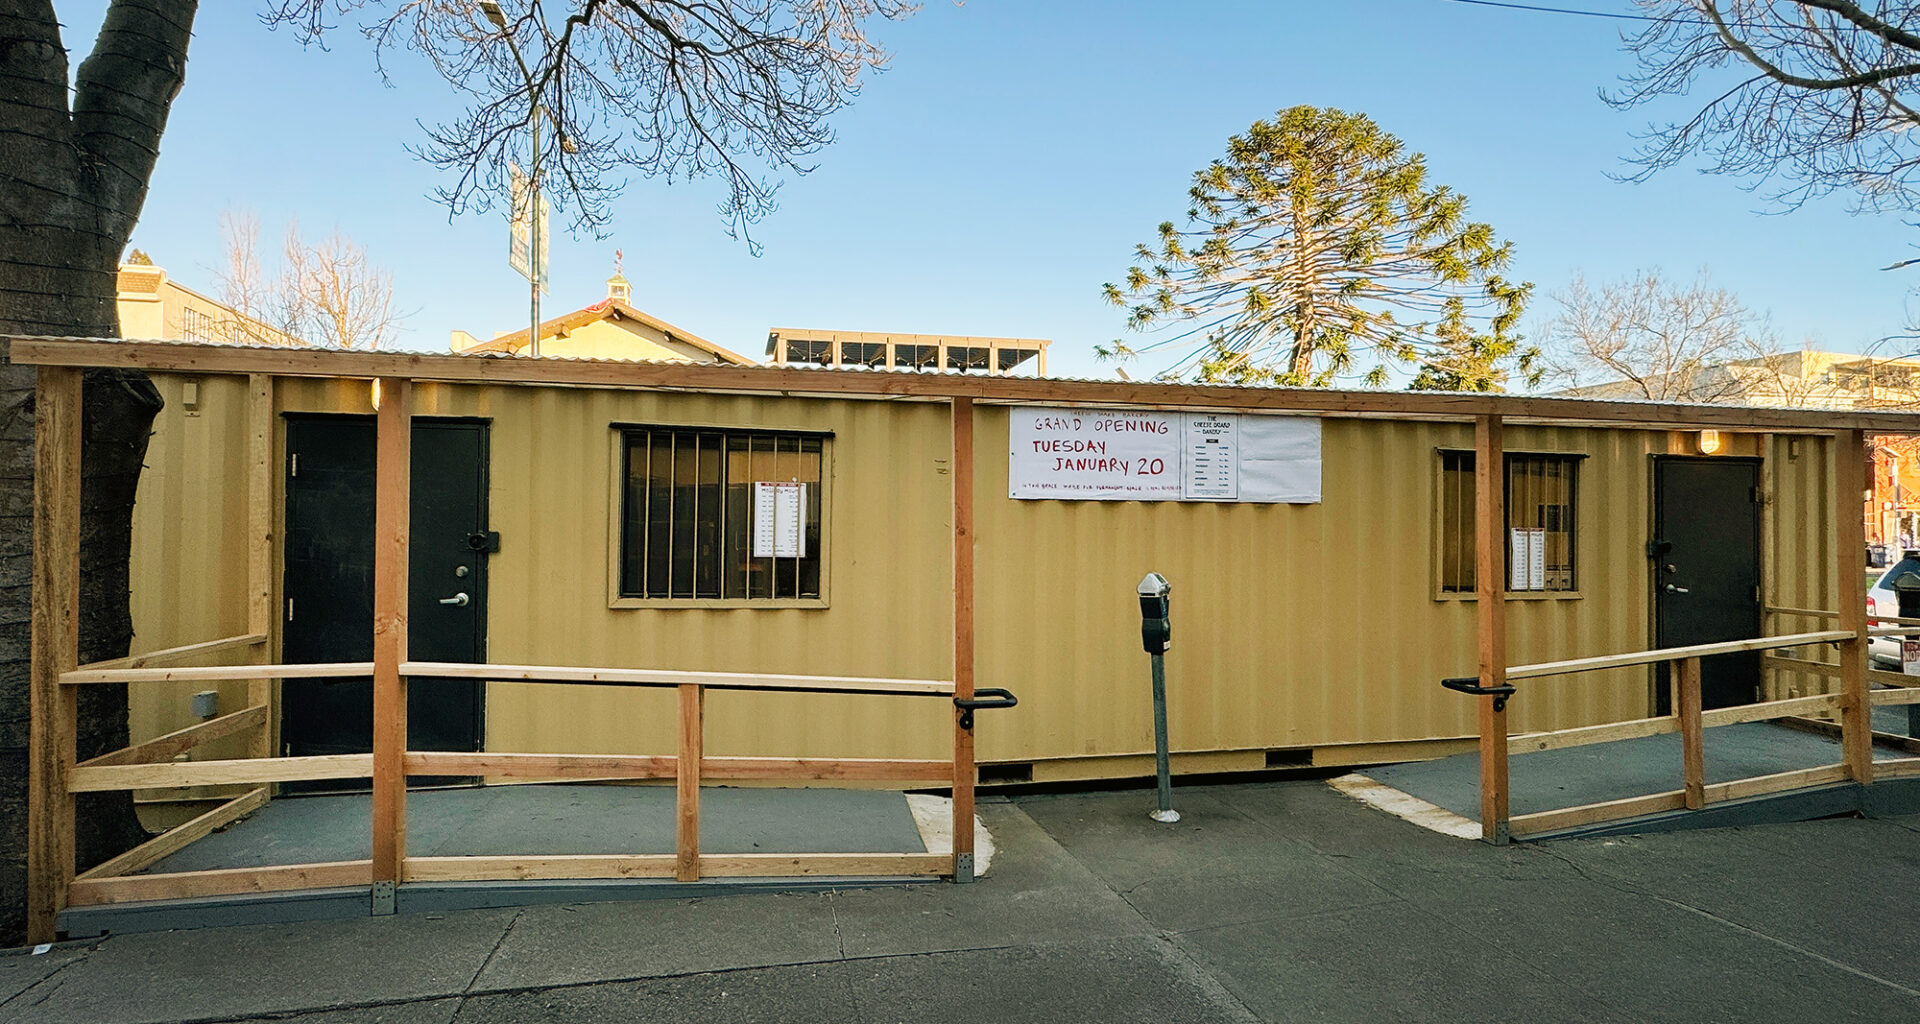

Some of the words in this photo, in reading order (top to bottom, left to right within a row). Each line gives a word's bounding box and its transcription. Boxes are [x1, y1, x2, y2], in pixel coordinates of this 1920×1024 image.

[1034, 418, 1082, 431] GRAND
[1094, 419, 1169, 435] OPENING
[1033, 440, 1106, 454] TUESDAY
[1052, 457, 1129, 475] JANUARY
[1137, 458, 1164, 475] 20
